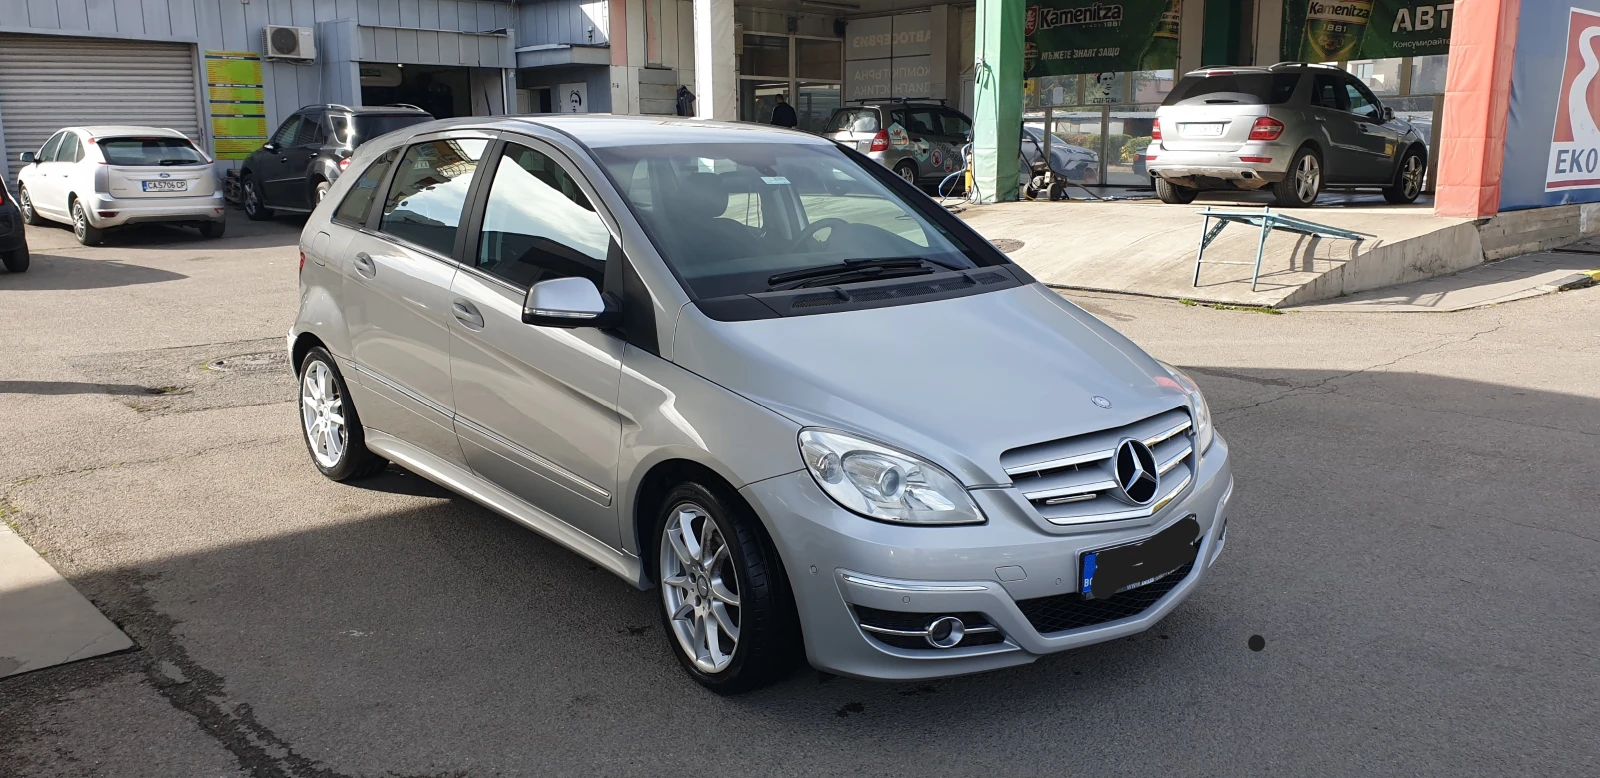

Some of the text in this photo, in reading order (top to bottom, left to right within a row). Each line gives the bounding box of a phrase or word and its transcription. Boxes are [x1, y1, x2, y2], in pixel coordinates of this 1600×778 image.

[1040, 3, 1122, 29] Kamenitza
[1309, 2, 1370, 18] Kamenitza
[1323, 24, 1347, 32] 1881
[1041, 50, 1072, 60] МЪЖЕТЕ
[1073, 48, 1097, 58] ЗНАЯТ
[1098, 47, 1120, 57] ЗАЩО
[1555, 148, 1598, 174] EKO
